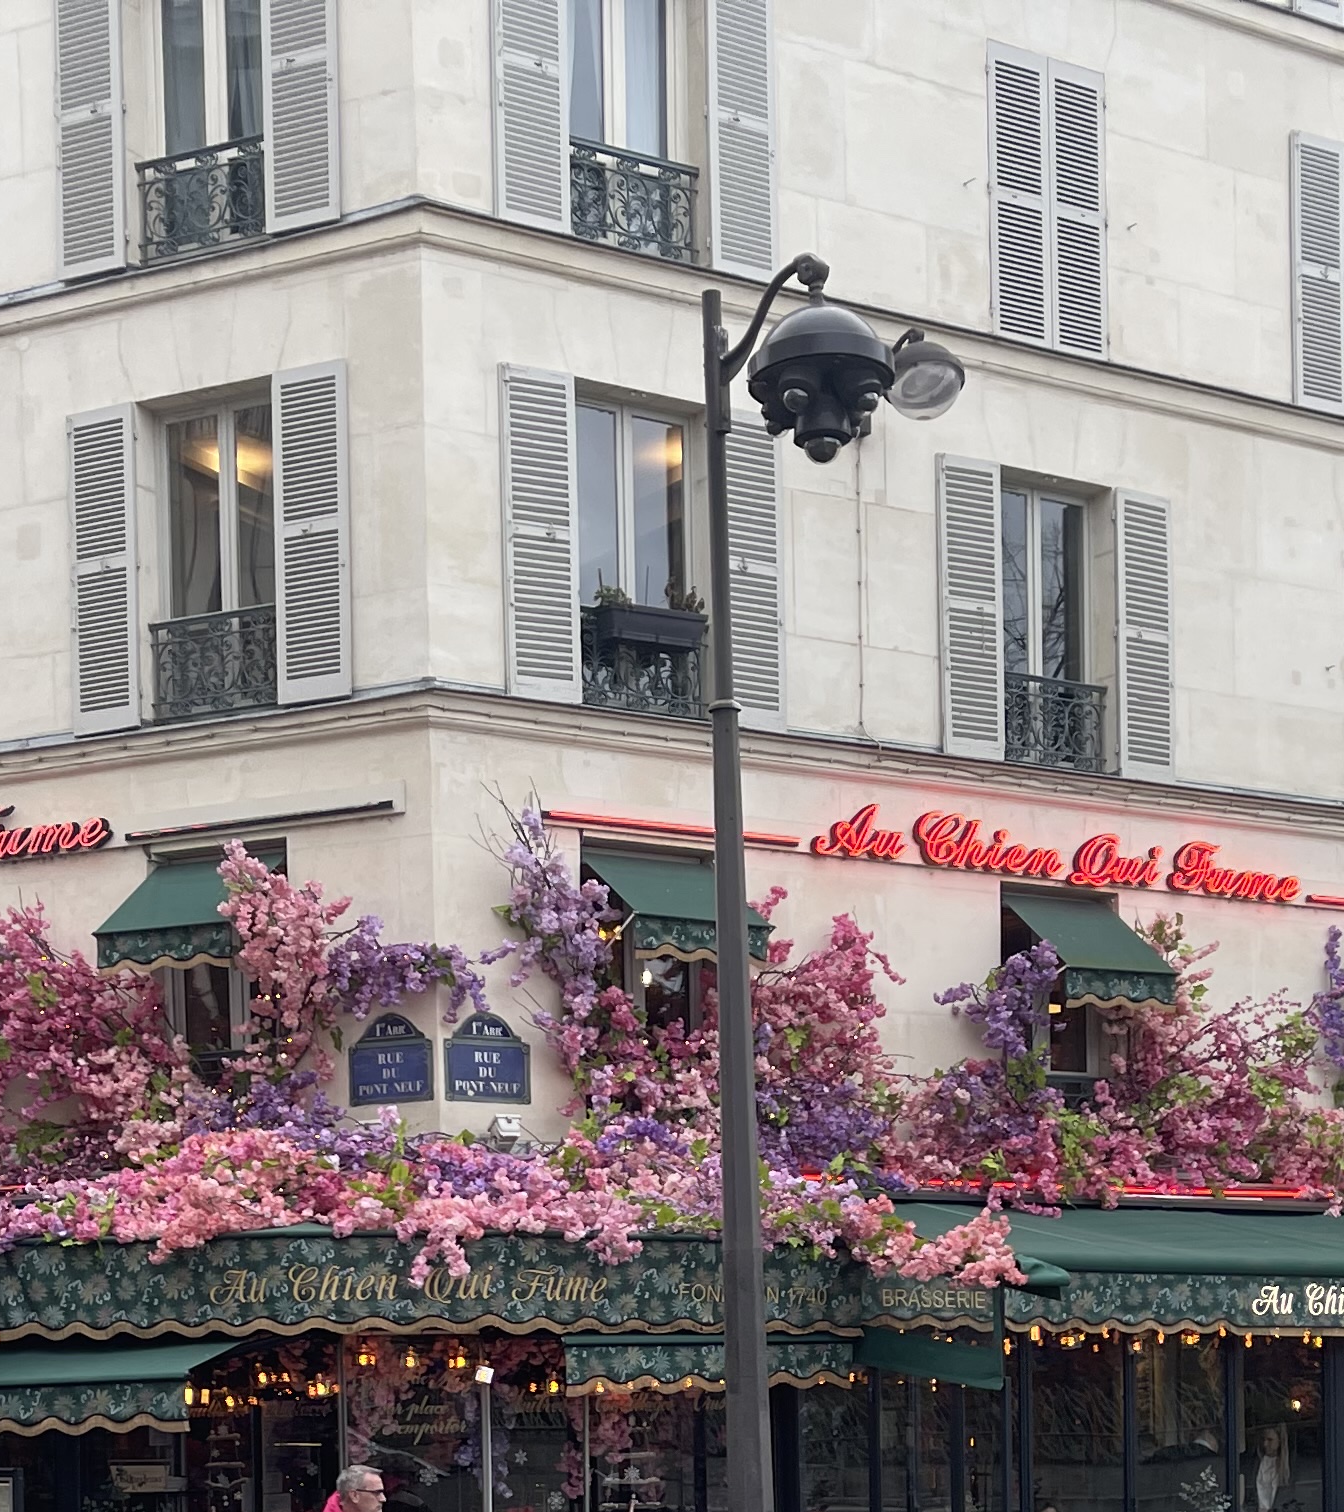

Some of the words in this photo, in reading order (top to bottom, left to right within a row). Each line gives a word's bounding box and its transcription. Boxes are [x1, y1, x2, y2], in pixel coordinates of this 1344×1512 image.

[813, 803, 908, 858] Au
[913, 809, 1065, 877] Chien
[1067, 832, 1164, 888] Qui
[1168, 841, 1302, 901] Fume
[378, 1051, 404, 1065] RUE
[474, 1051, 501, 1065] RUE
[382, 1067, 399, 1079] DU
[479, 1066, 496, 1078] DU
[209, 1268, 267, 1304] Au
[287, 1262, 398, 1303] Chien
[423, 1265, 494, 1304] Qui
[512, 1264, 609, 1302] Fume
[787, 1287, 827, 1307] 1740
[882, 1288, 987, 1310] BRASSERIE
[1252, 1285, 1295, 1317] Au
